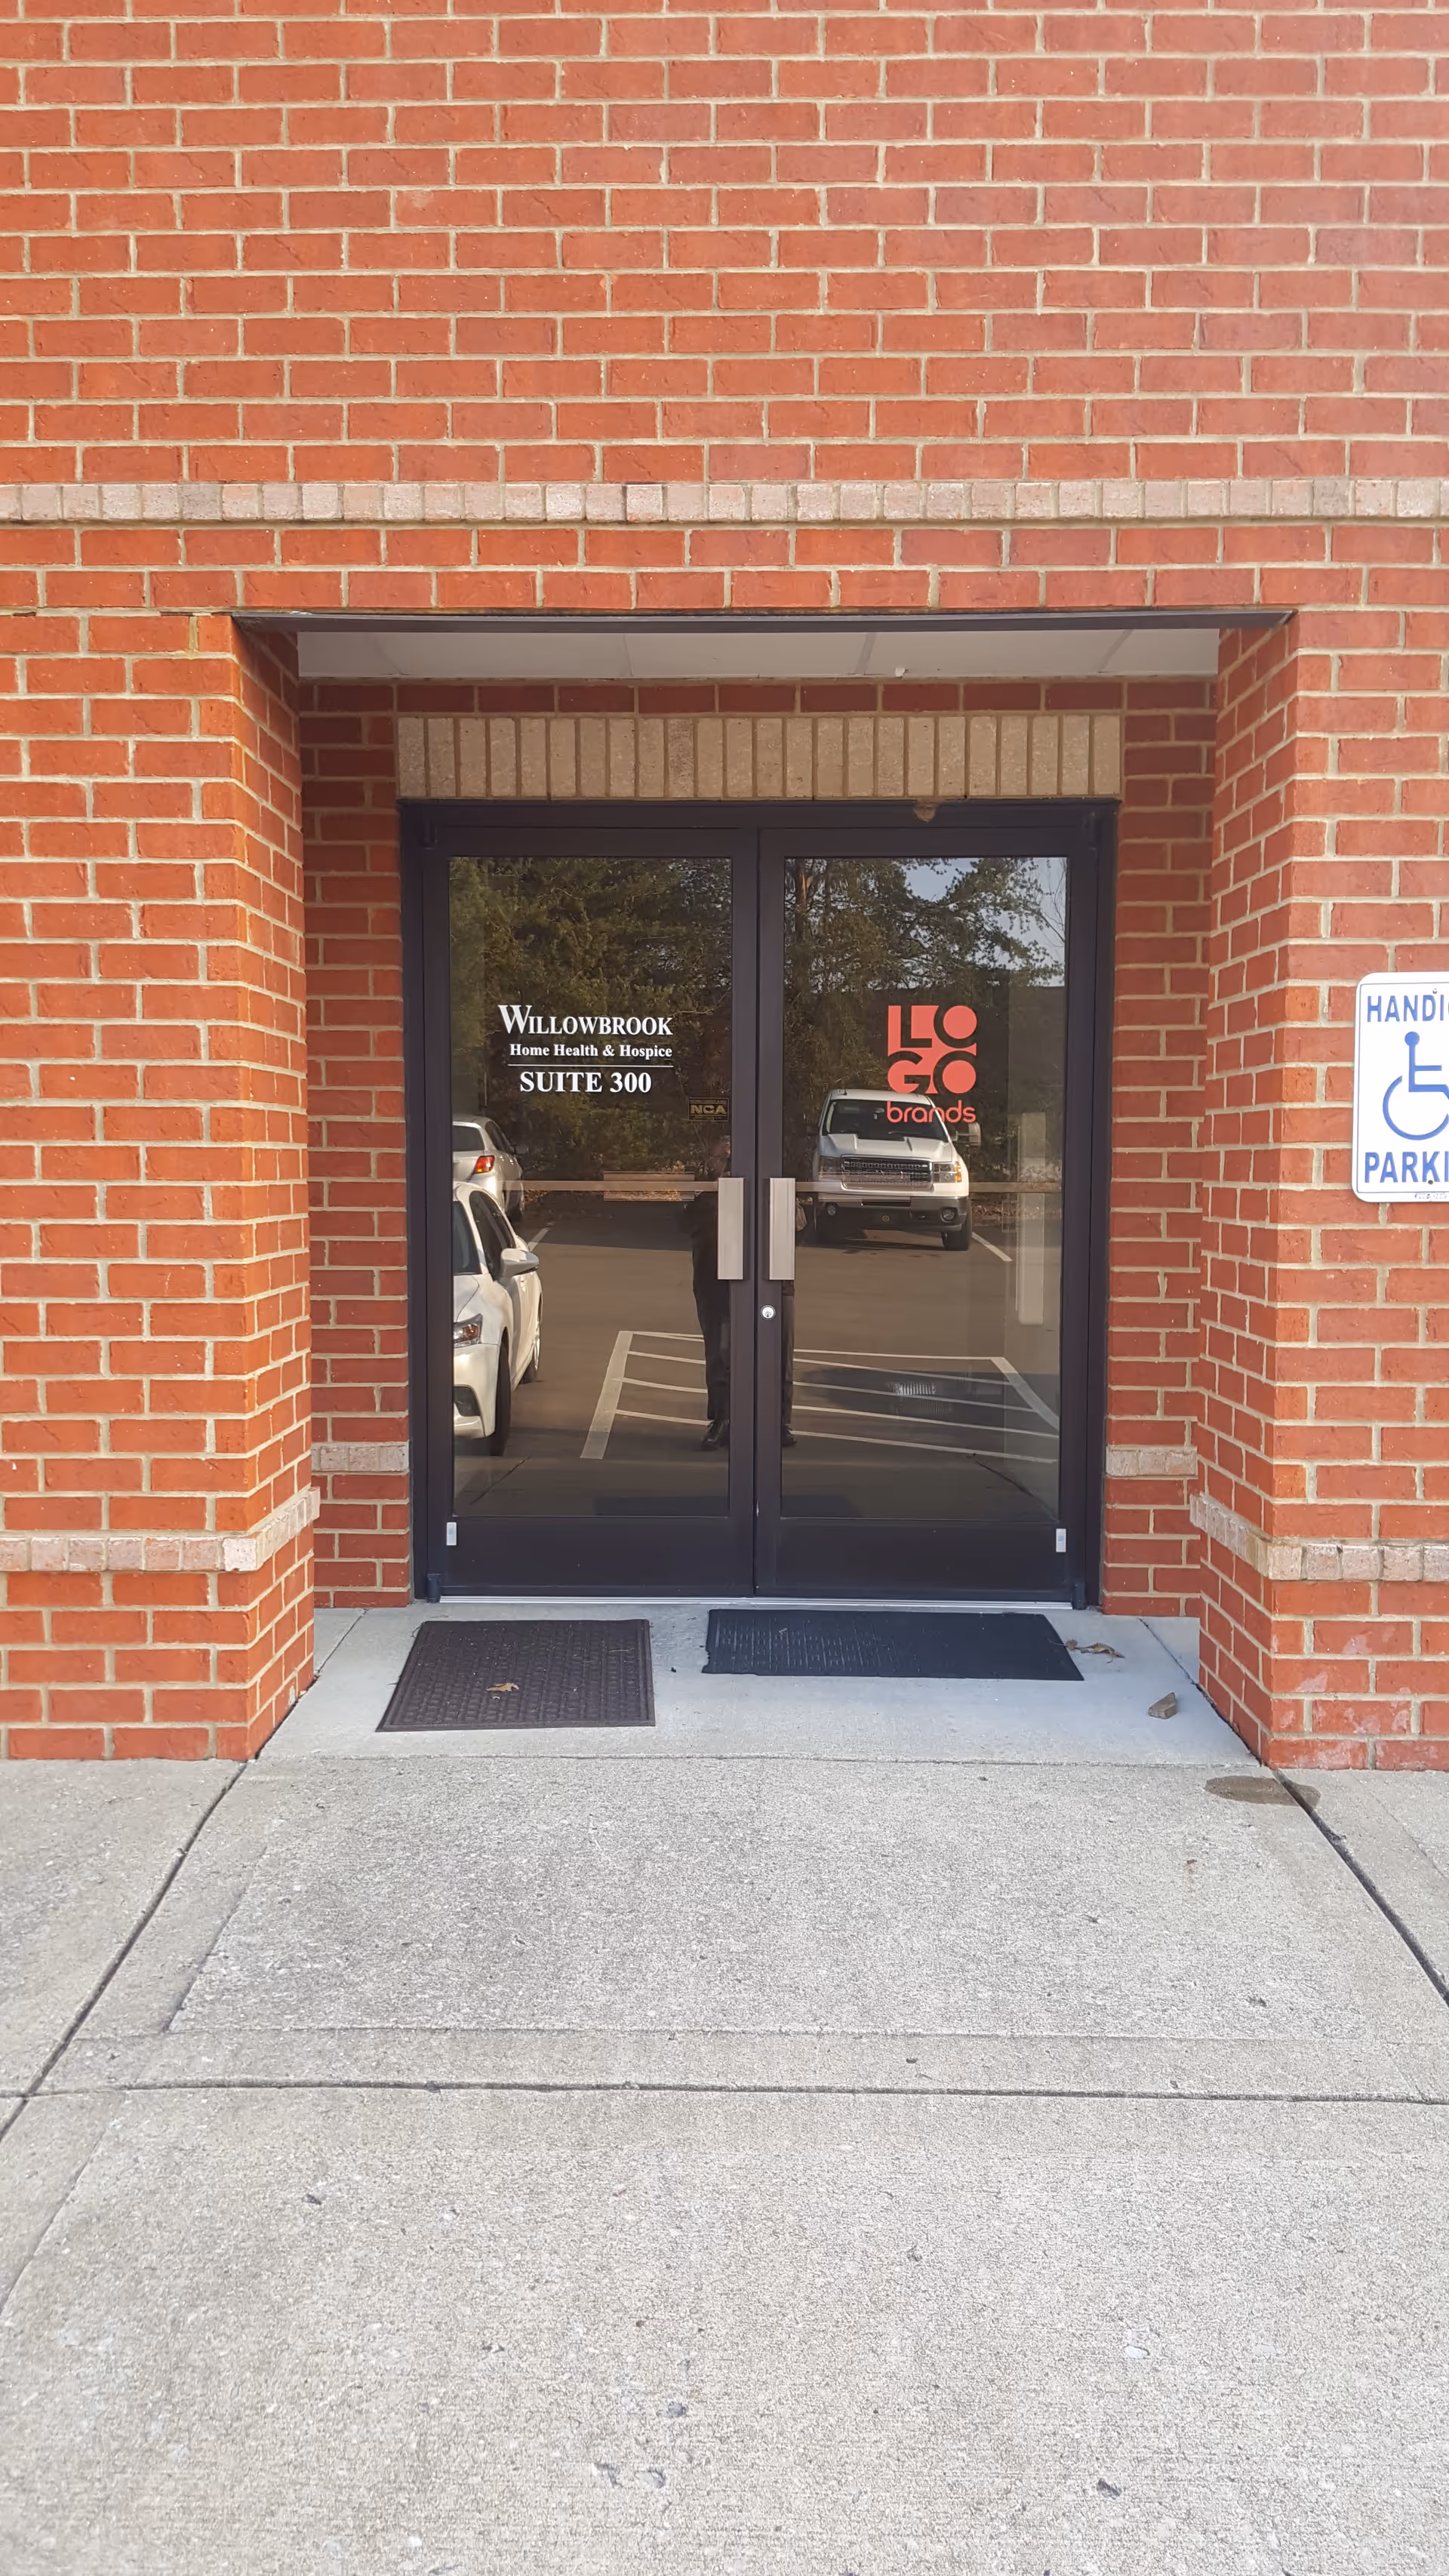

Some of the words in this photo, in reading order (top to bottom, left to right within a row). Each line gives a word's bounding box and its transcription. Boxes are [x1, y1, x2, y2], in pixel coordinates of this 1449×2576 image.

[1367, 994, 1449, 1023] HANDI
[509, 1043, 550, 1057] Home
[553, 1044, 598, 1057] Health
[602, 1045, 616, 1057] &
[620, 1045, 673, 1060] Hospice
[520, 1071, 603, 1093] SUITE
[609, 1071, 652, 1094] 300
[690, 1104, 728, 1115] NCA
[886, 1099, 977, 1124] brands
